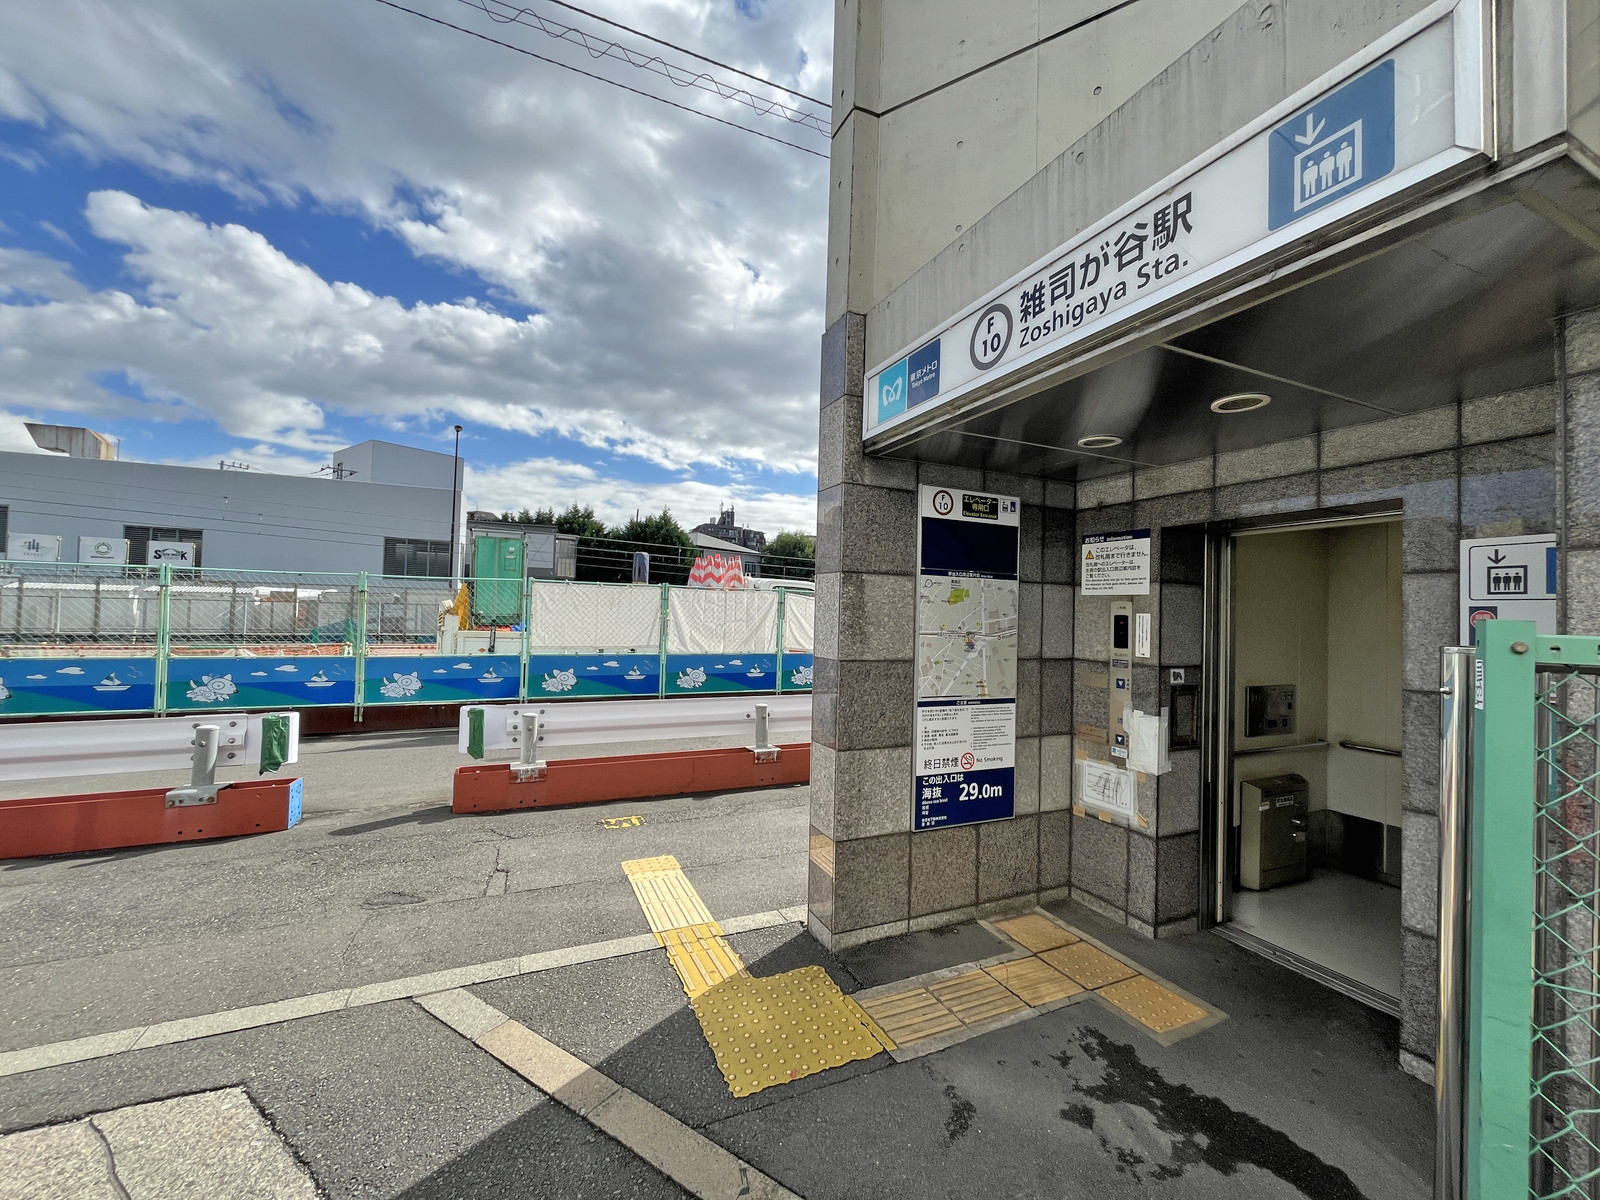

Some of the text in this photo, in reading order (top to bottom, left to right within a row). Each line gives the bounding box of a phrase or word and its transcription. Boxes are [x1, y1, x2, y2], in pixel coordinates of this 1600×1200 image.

[1019, 191, 1194, 324] 雑司が谷駅
[1019, 253, 1189, 348] Zoshigaya Sta.
[987, 315, 995, 335] F
[982, 332, 1001, 357] 10
[910, 360, 938, 383] 東京メトロ
[911, 379, 923, 389] Tokyo
[964, 496, 998, 504] エレベーター
[923, 756, 960, 770] 終日禁煙
[922, 773, 965, 786] この出入口は
[921, 786, 942, 800] 海抜
[958, 782, 1003, 801] 29.0m
